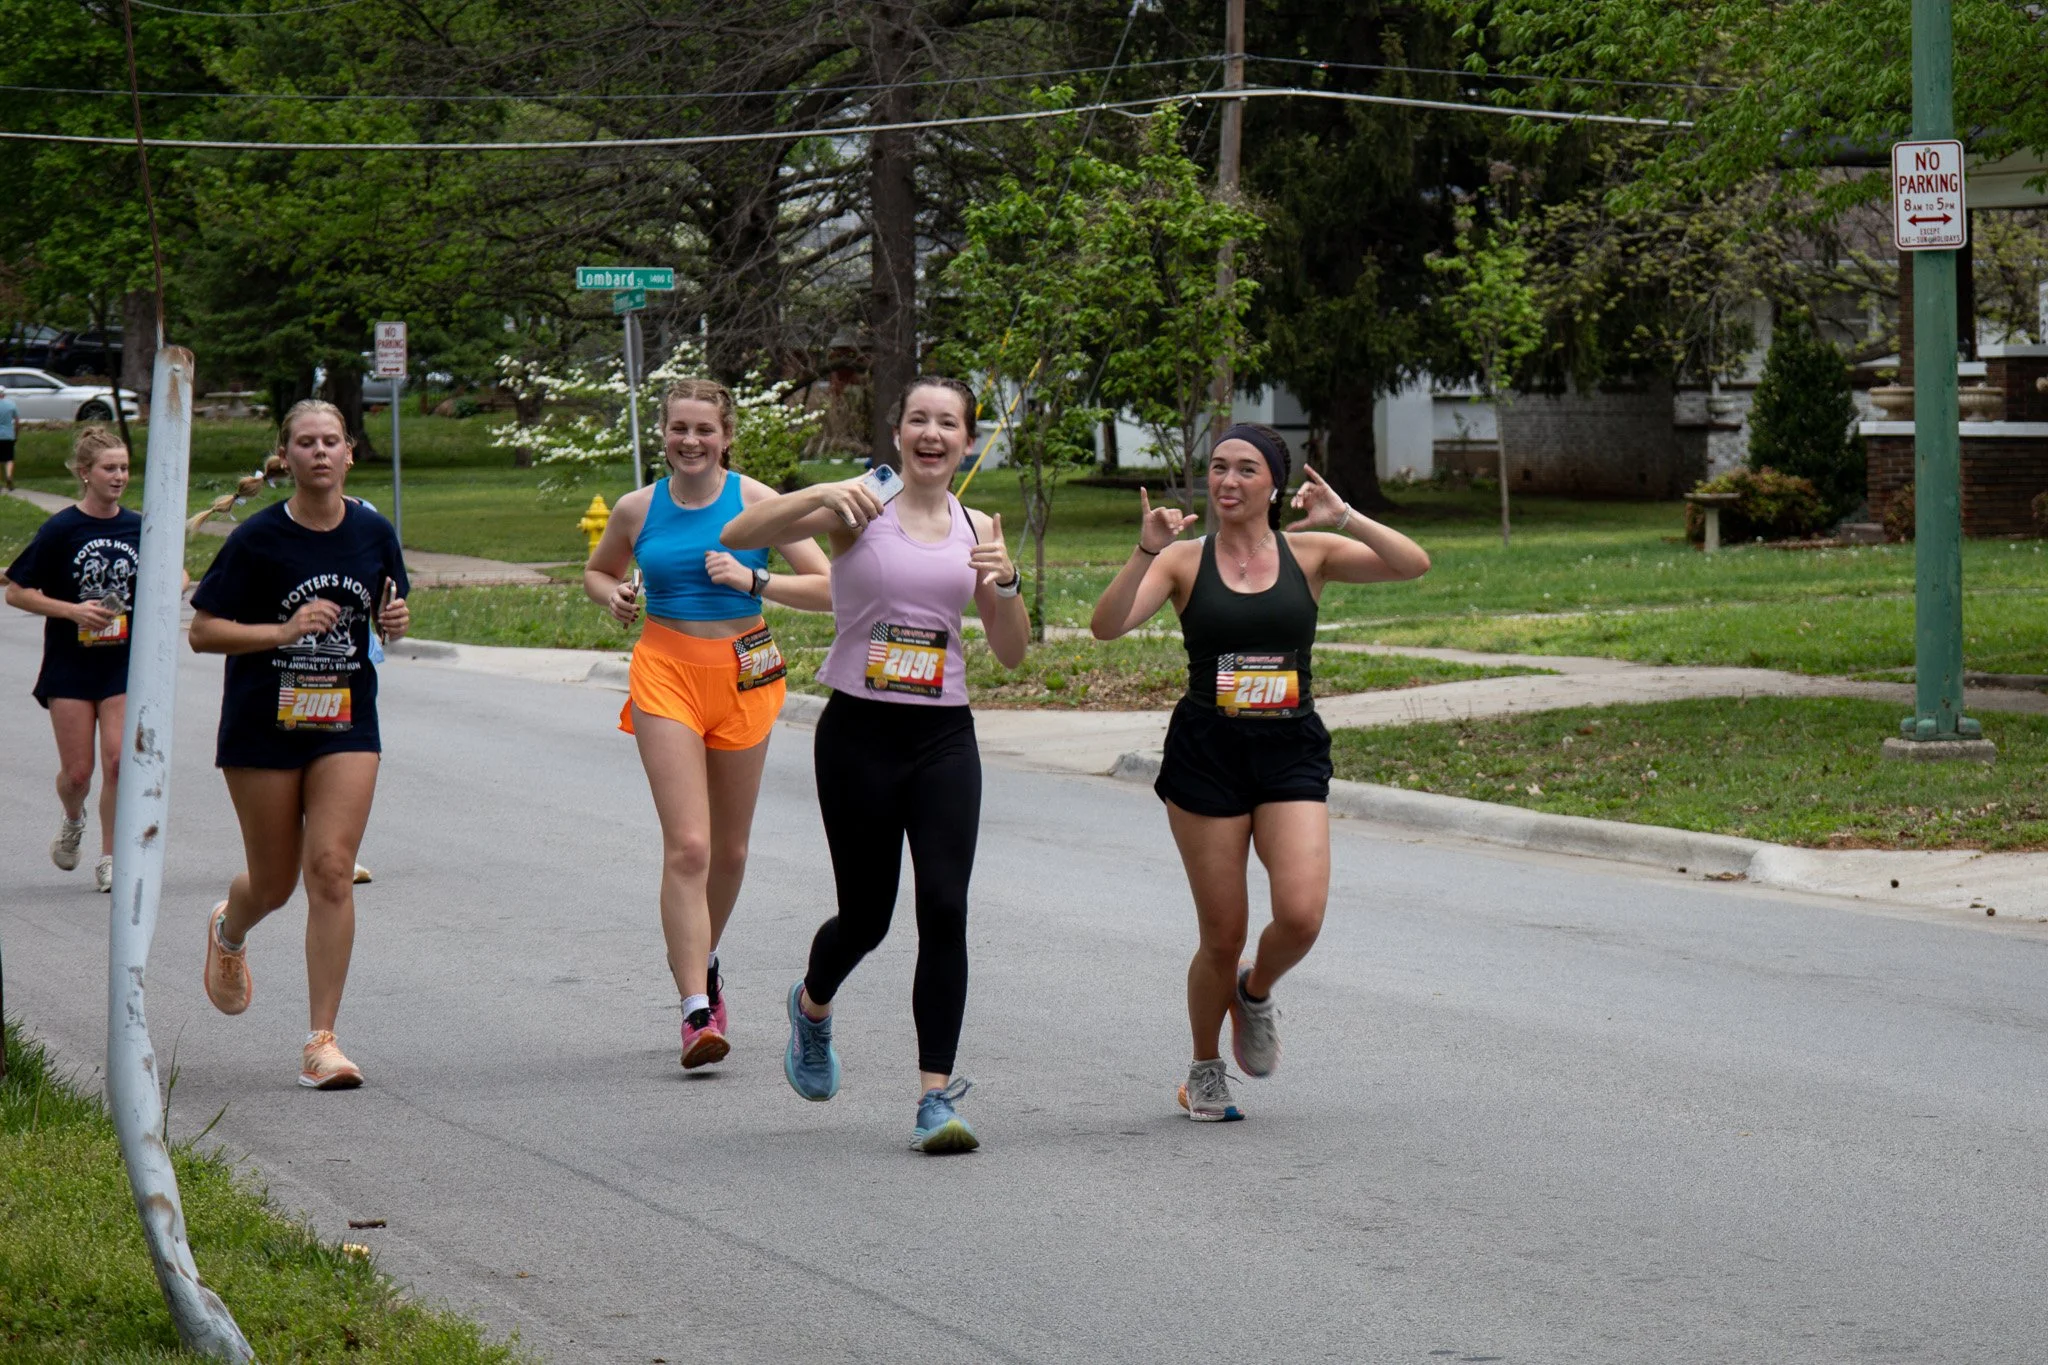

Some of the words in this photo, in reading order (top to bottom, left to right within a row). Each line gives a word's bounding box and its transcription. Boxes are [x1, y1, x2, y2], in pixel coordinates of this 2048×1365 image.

[1915, 151, 1940, 171] NO
[1899, 173, 1958, 194] PARKING
[1926, 203, 1934, 211] TO
[1920, 227, 1940, 235] EXCEPT
[578, 270, 634, 287] Lombard
[384, 327, 396, 338] NO
[73, 538, 112, 565] POTTER'S
[281, 573, 339, 610] POTTER'S
[271, 658, 287, 669] 4TH
[288, 661, 318, 671] ANNUAL
[883, 647, 939, 681] 2096
[1234, 675, 1288, 704] 2210
[292, 692, 343, 718] 2003
